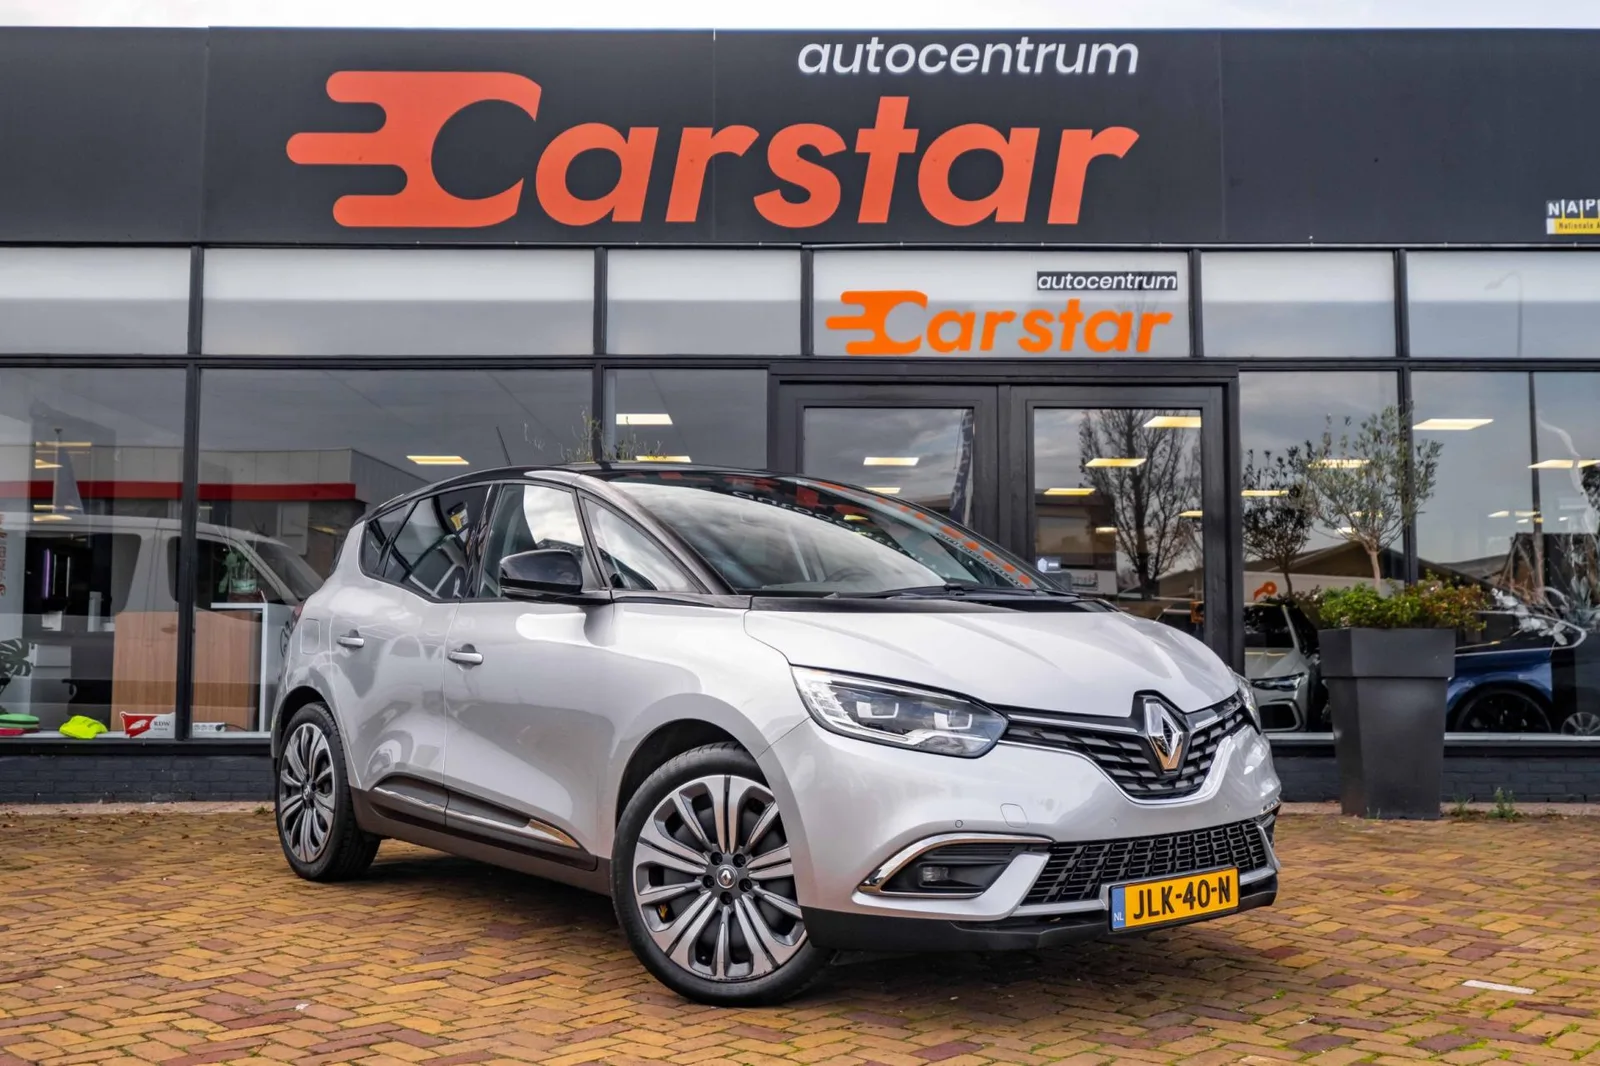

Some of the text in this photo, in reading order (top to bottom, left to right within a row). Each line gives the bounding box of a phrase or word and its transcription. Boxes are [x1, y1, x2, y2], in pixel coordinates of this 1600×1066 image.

[797, 36, 1139, 76] autocentrum
[286, 70, 1139, 229] Carstar
[1037, 272, 1177, 290] autocentrum
[826, 290, 1173, 356] Carstar
[1113, 912, 1124, 922] NL
[1133, 875, 1231, 920] JLK-40-N
